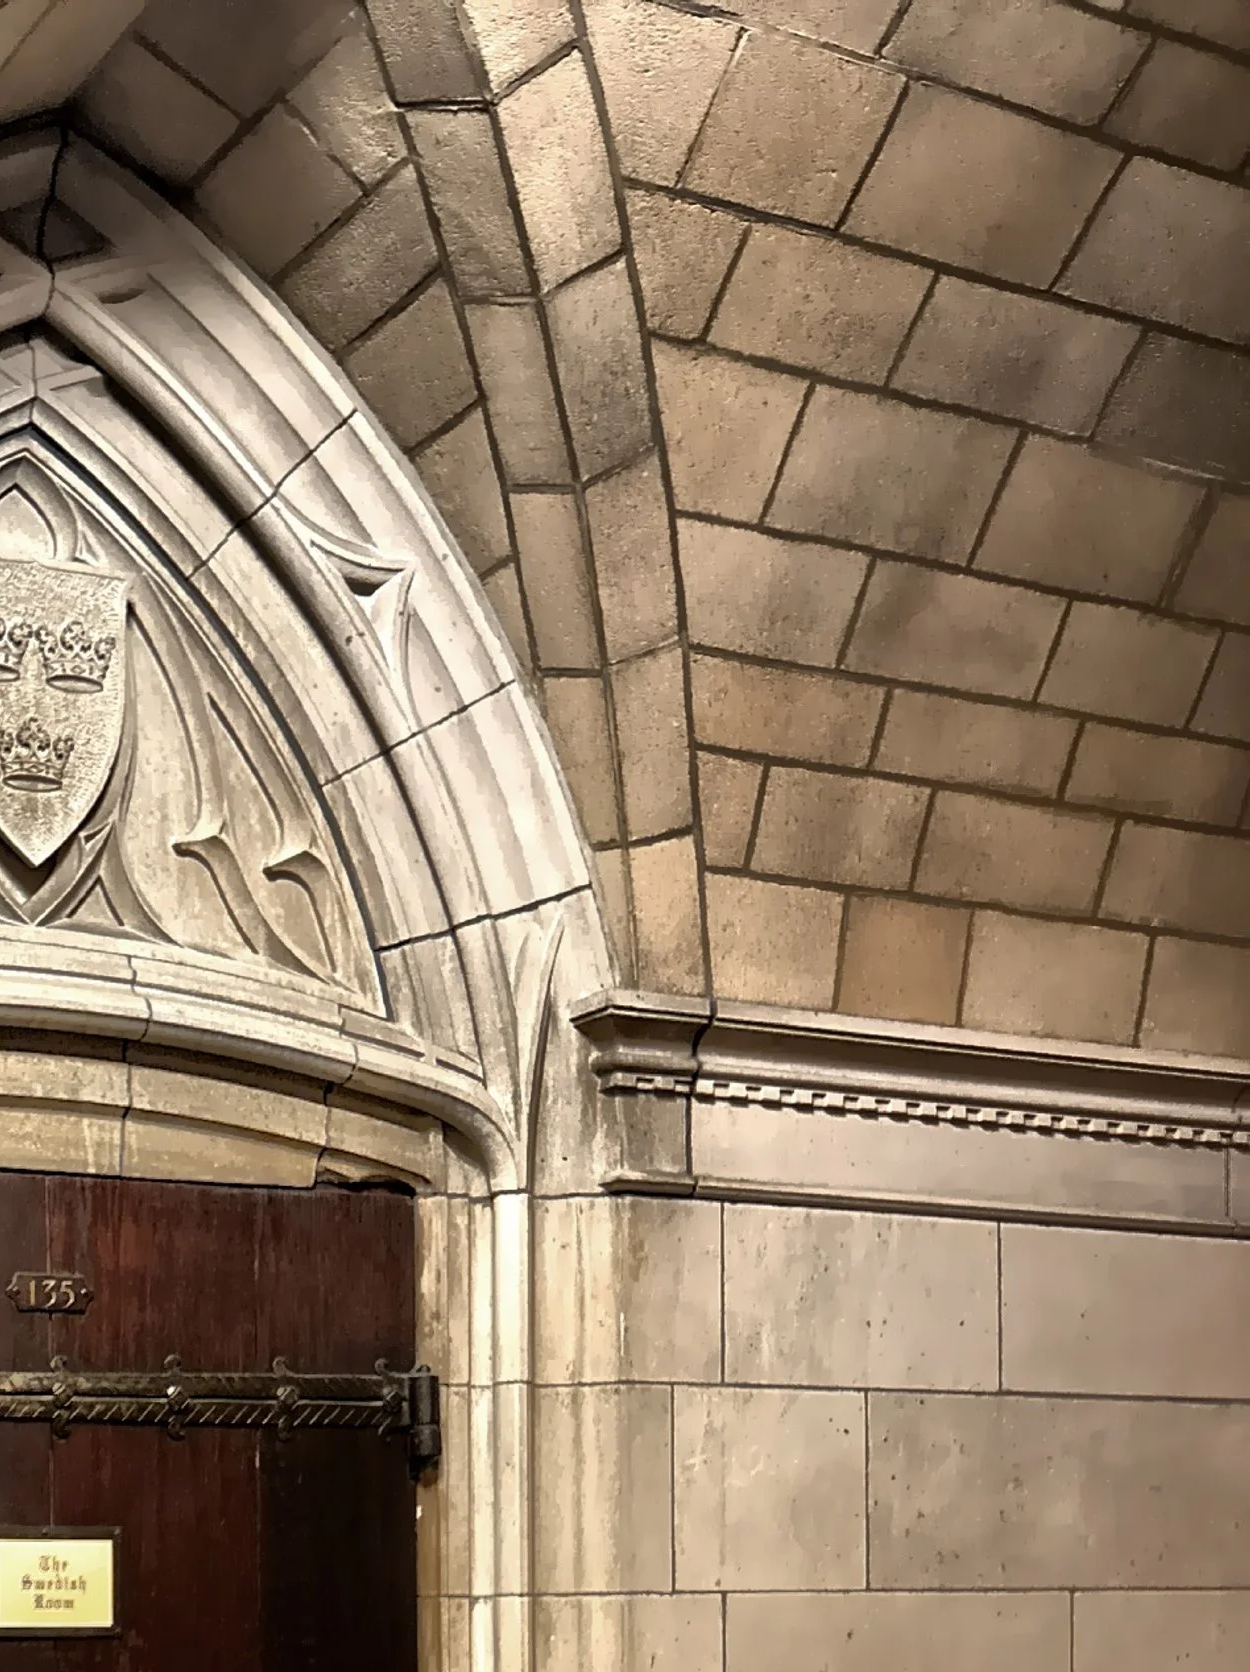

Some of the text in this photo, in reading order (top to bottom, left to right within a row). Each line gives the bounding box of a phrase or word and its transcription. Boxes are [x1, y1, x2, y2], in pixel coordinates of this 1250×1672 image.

[29, 1279, 75, 1308] 135
[39, 1555, 68, 1572] The
[21, 1574, 87, 1594] Swedish
[34, 1594, 75, 1609] Room
